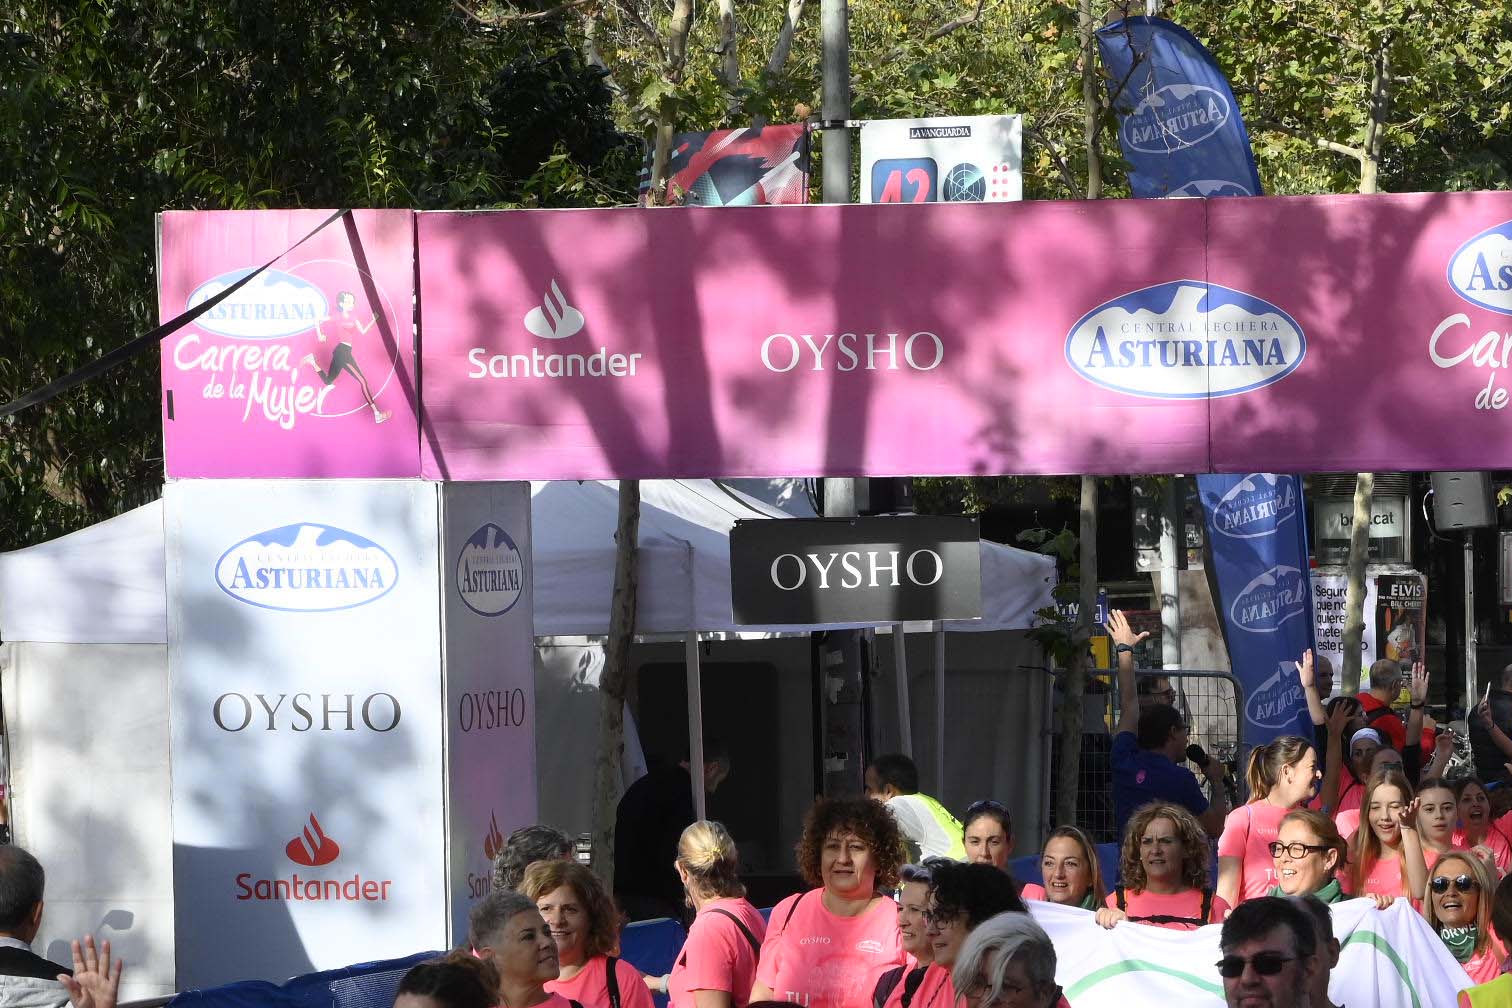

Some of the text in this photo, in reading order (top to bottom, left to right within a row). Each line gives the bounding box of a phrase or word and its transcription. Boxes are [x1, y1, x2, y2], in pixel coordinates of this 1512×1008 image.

[920, 127, 970, 137] VANGUARDIA
[174, 334, 290, 371] Carrera
[468, 346, 641, 378] Santander
[761, 331, 944, 373] OYSHO
[1085, 325, 1288, 368] ASTURIANA
[203, 366, 335, 430] de la Mujer
[1475, 372, 1510, 410] de
[229, 557, 386, 590] ASTURIANA
[461, 556, 520, 594] ASTURIANA
[771, 549, 943, 590] OYSHO
[1316, 602, 1331, 612] que
[1391, 585, 1421, 597] ELVIS
[1318, 641, 1337, 651] este
[212, 692, 401, 732] OYSHO
[460, 688, 525, 732] OYSHO
[235, 872, 392, 901] Santander
[468, 873, 493, 900] Sant
